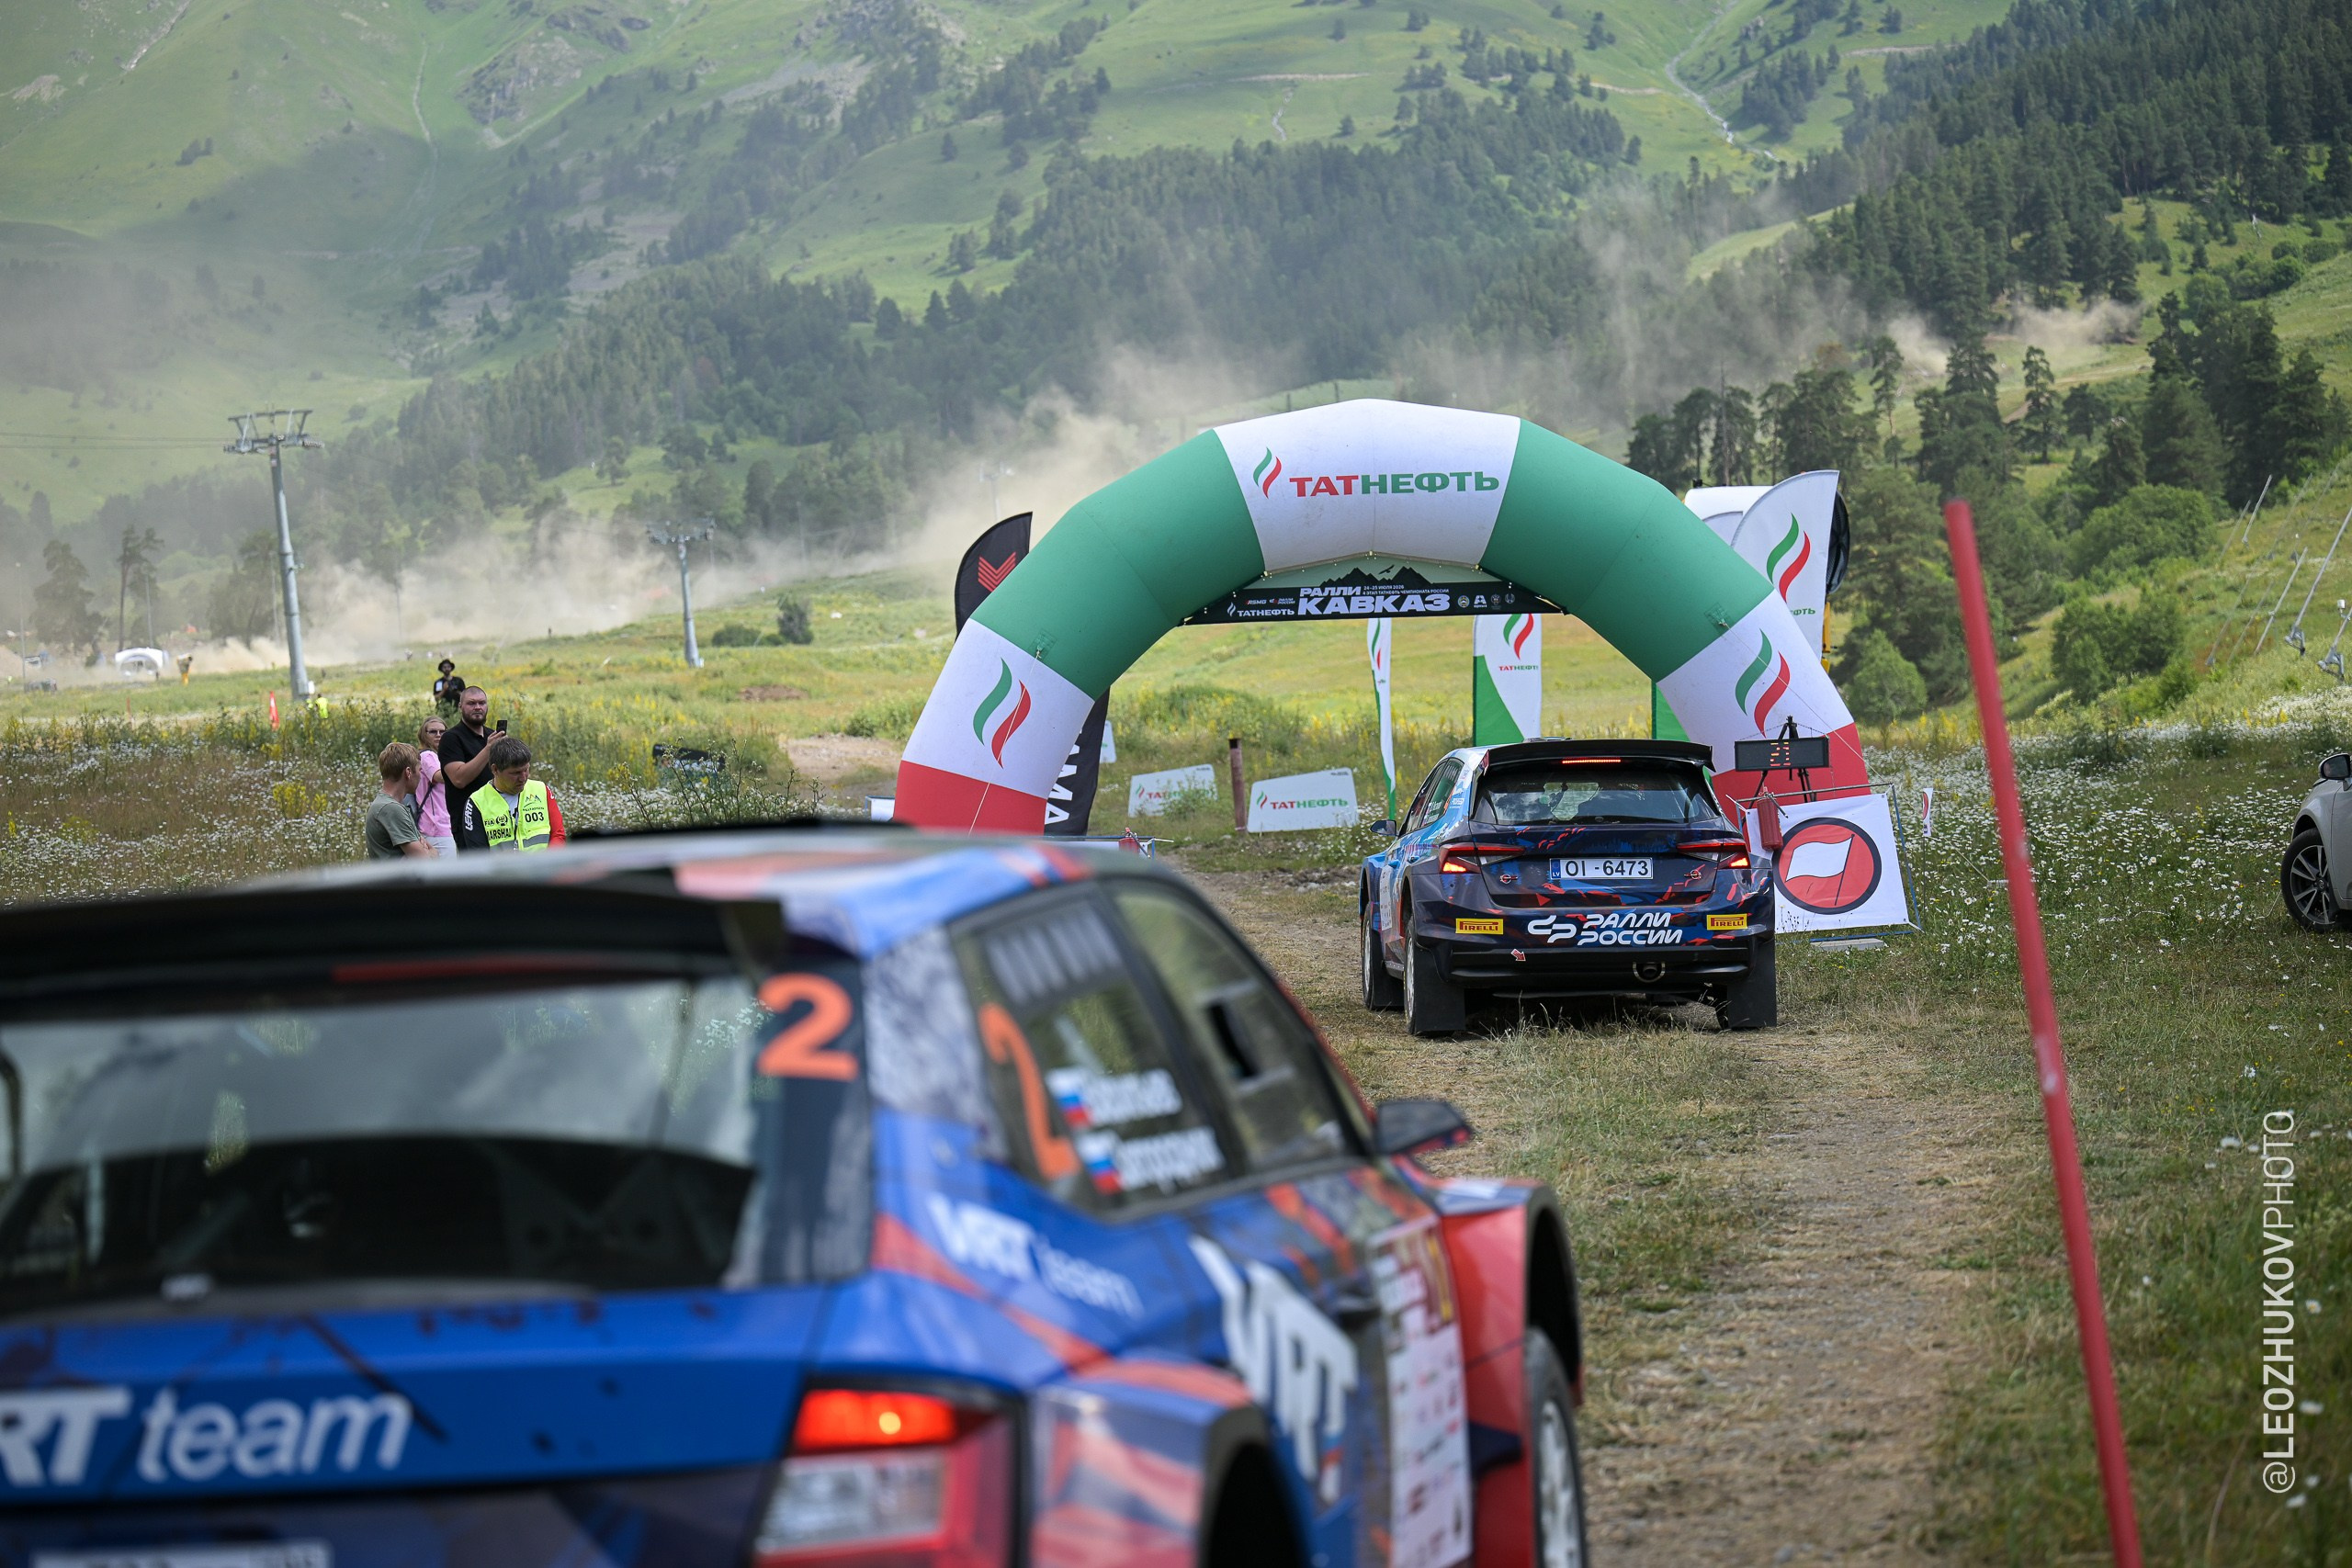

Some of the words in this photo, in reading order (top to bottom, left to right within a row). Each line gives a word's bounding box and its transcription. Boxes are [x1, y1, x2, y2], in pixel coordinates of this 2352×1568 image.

[1289, 471, 1499, 498] ТАТНЕФТЬ
[1299, 586, 1362, 597] РАЛЛИ
[1237, 608, 1295, 617] ТАТНЕФТЬ
[1297, 593, 1451, 615] КАВКАЗ
[1270, 798, 1348, 809] ТАТНЕФТЬ
[525, 811, 544, 823] 003
[1459, 920, 1498, 931] PIRELLI
[1583, 912, 1671, 929] РАЛЛИ
[1711, 917, 1744, 927] PIRELLI
[1577, 929, 1682, 946] РОССИИ
[757, 974, 859, 1080] 2
[978, 1002, 1080, 1180] 2
[136, 1385, 413, 1483] team
